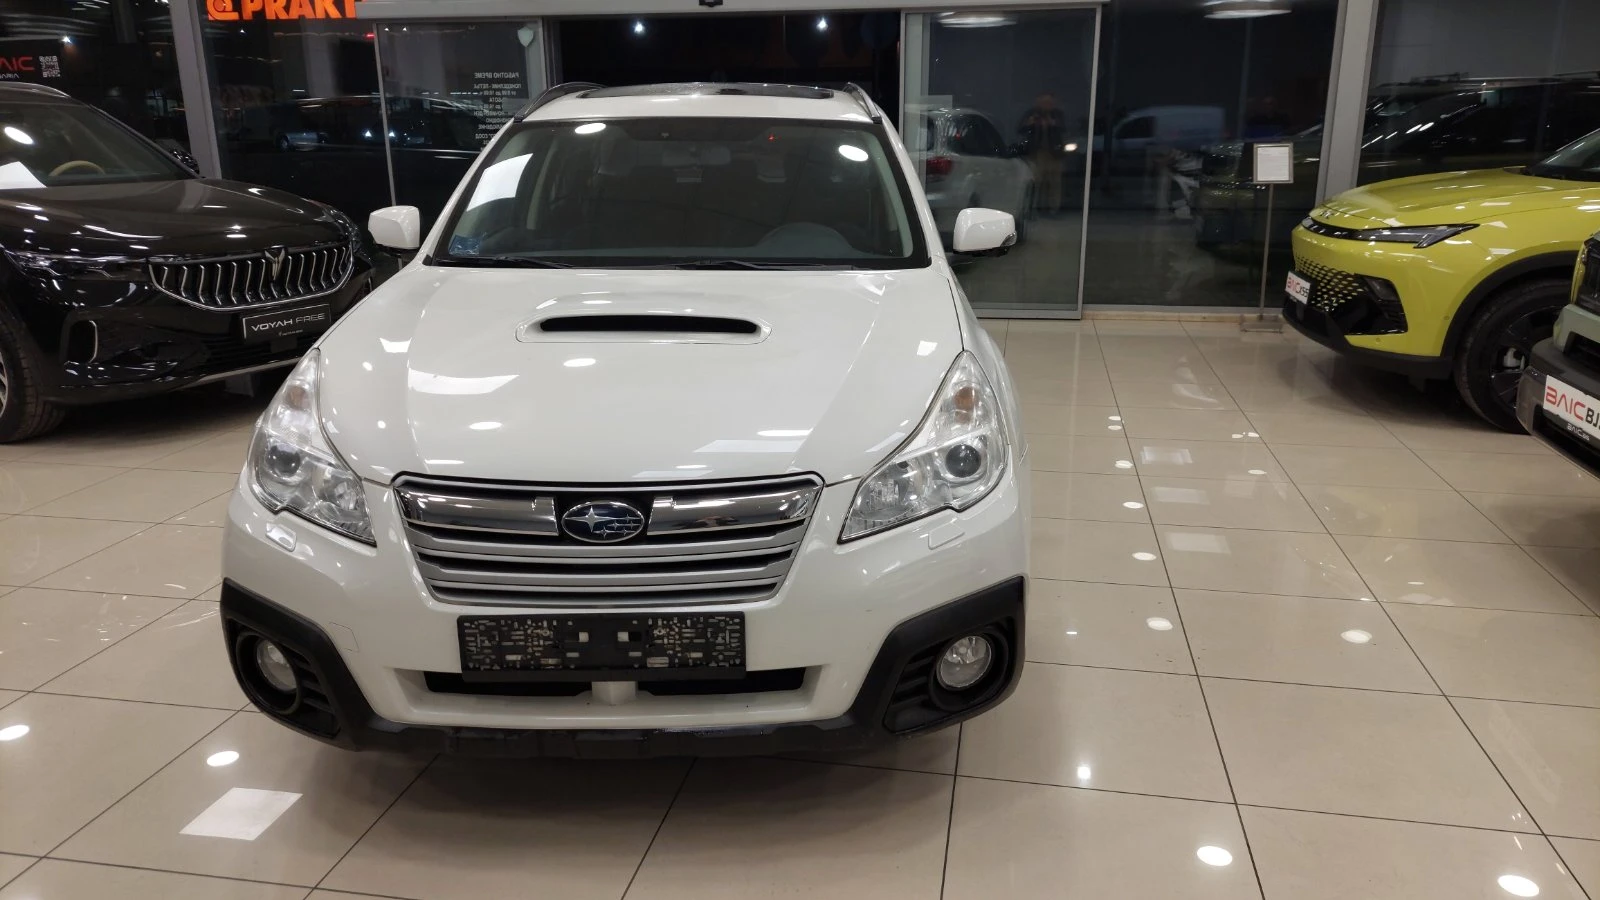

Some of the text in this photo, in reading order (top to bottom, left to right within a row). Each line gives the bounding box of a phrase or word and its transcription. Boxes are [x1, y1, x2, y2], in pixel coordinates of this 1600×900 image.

[0, 56, 34, 71] AIC
[251, 312, 326, 332] VOYAH FREE
[1546, 385, 1600, 430] BAIC BJ
